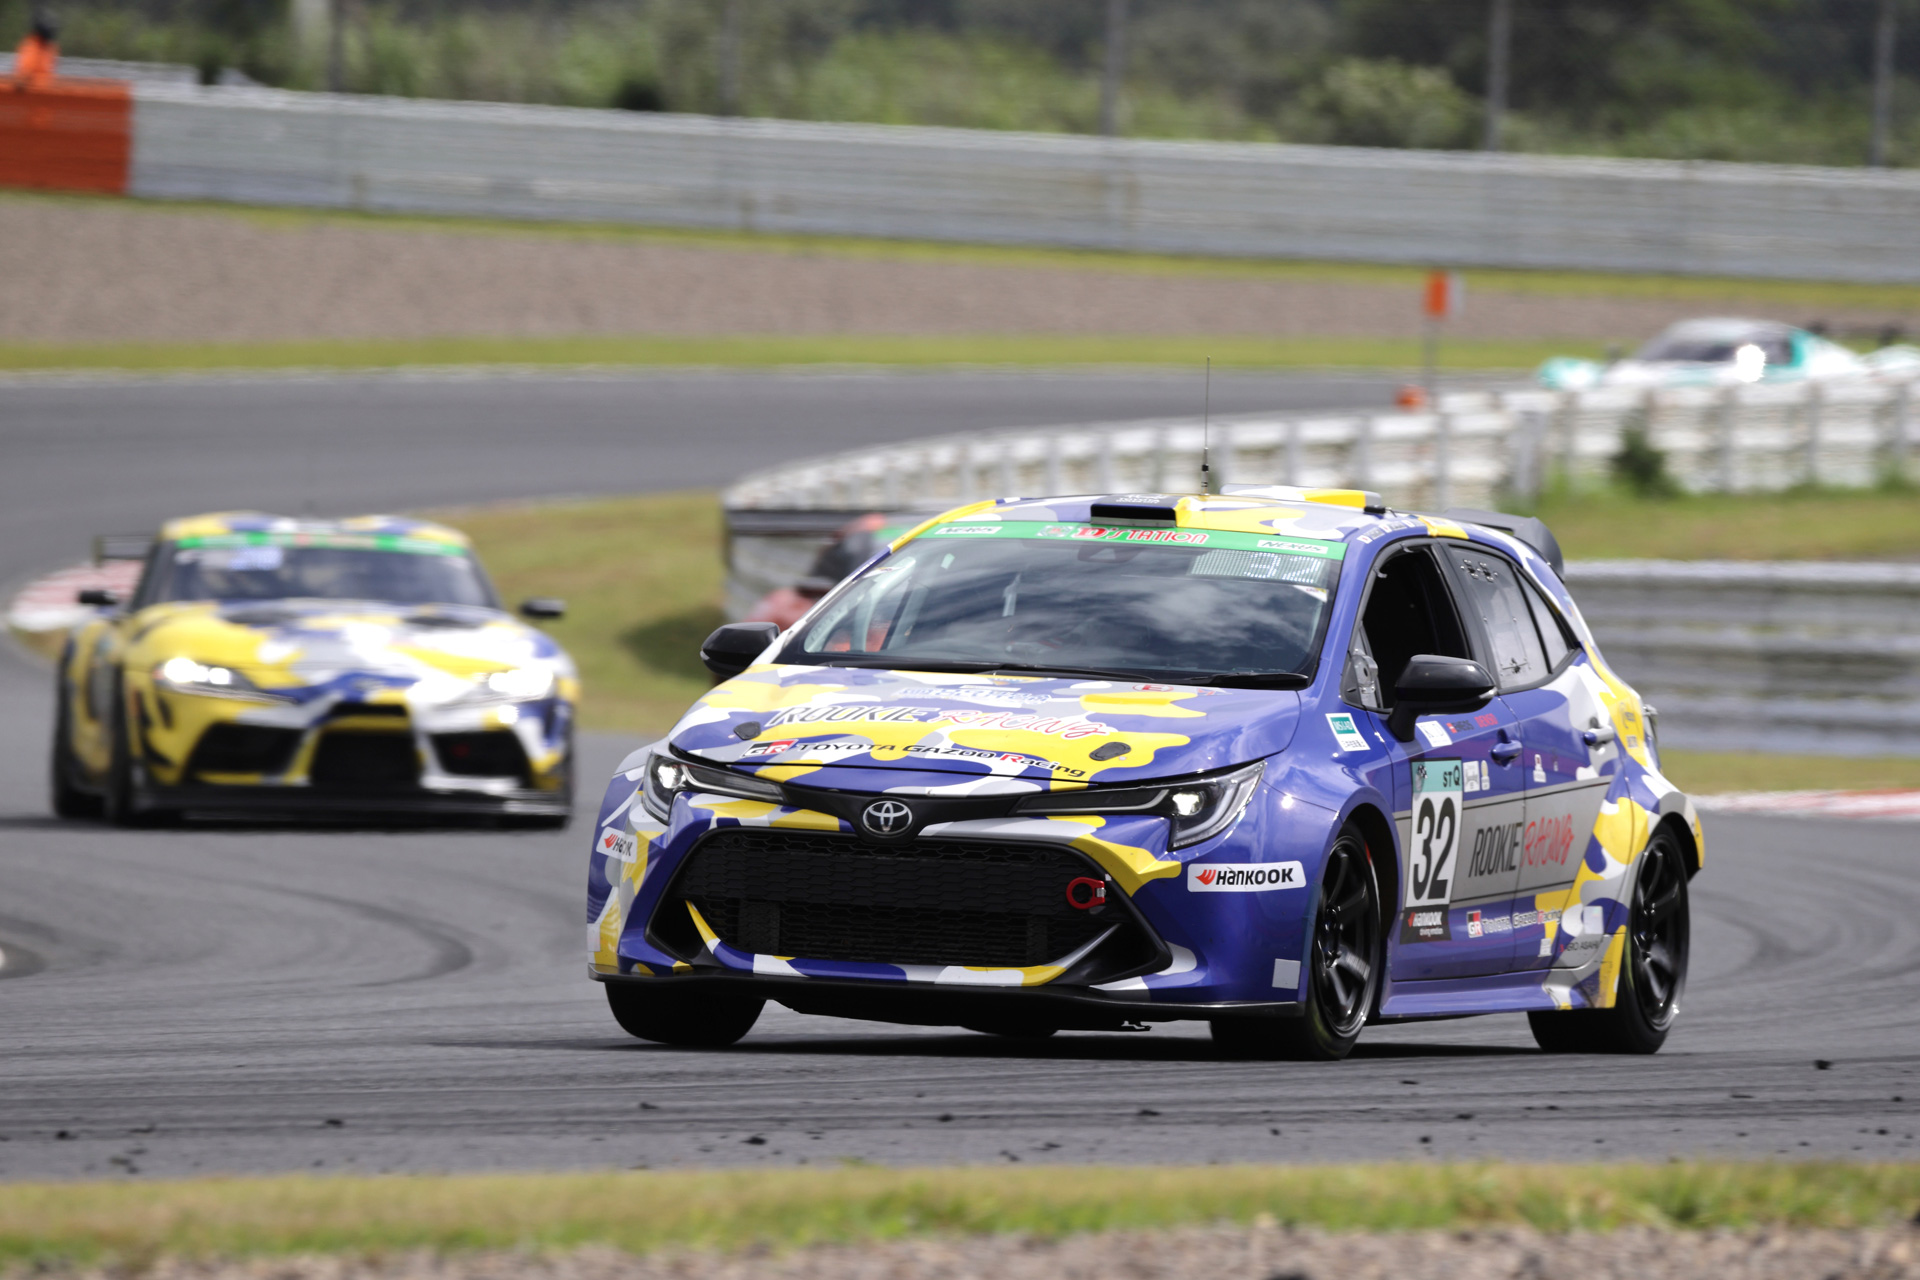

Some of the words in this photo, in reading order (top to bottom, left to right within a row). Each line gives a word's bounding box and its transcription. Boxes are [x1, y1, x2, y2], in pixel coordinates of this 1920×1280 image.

[766, 706, 932, 727] ROOKIE
[930, 711, 1108, 739] RACING
[800, 743, 895, 752] TOYOTA
[902, 744, 996, 759] GAZOO
[999, 753, 1086, 777] Racing
[1412, 797, 1456, 901] 32
[1468, 822, 1523, 878] ROOKIE
[1521, 813, 1575, 868] RACING
